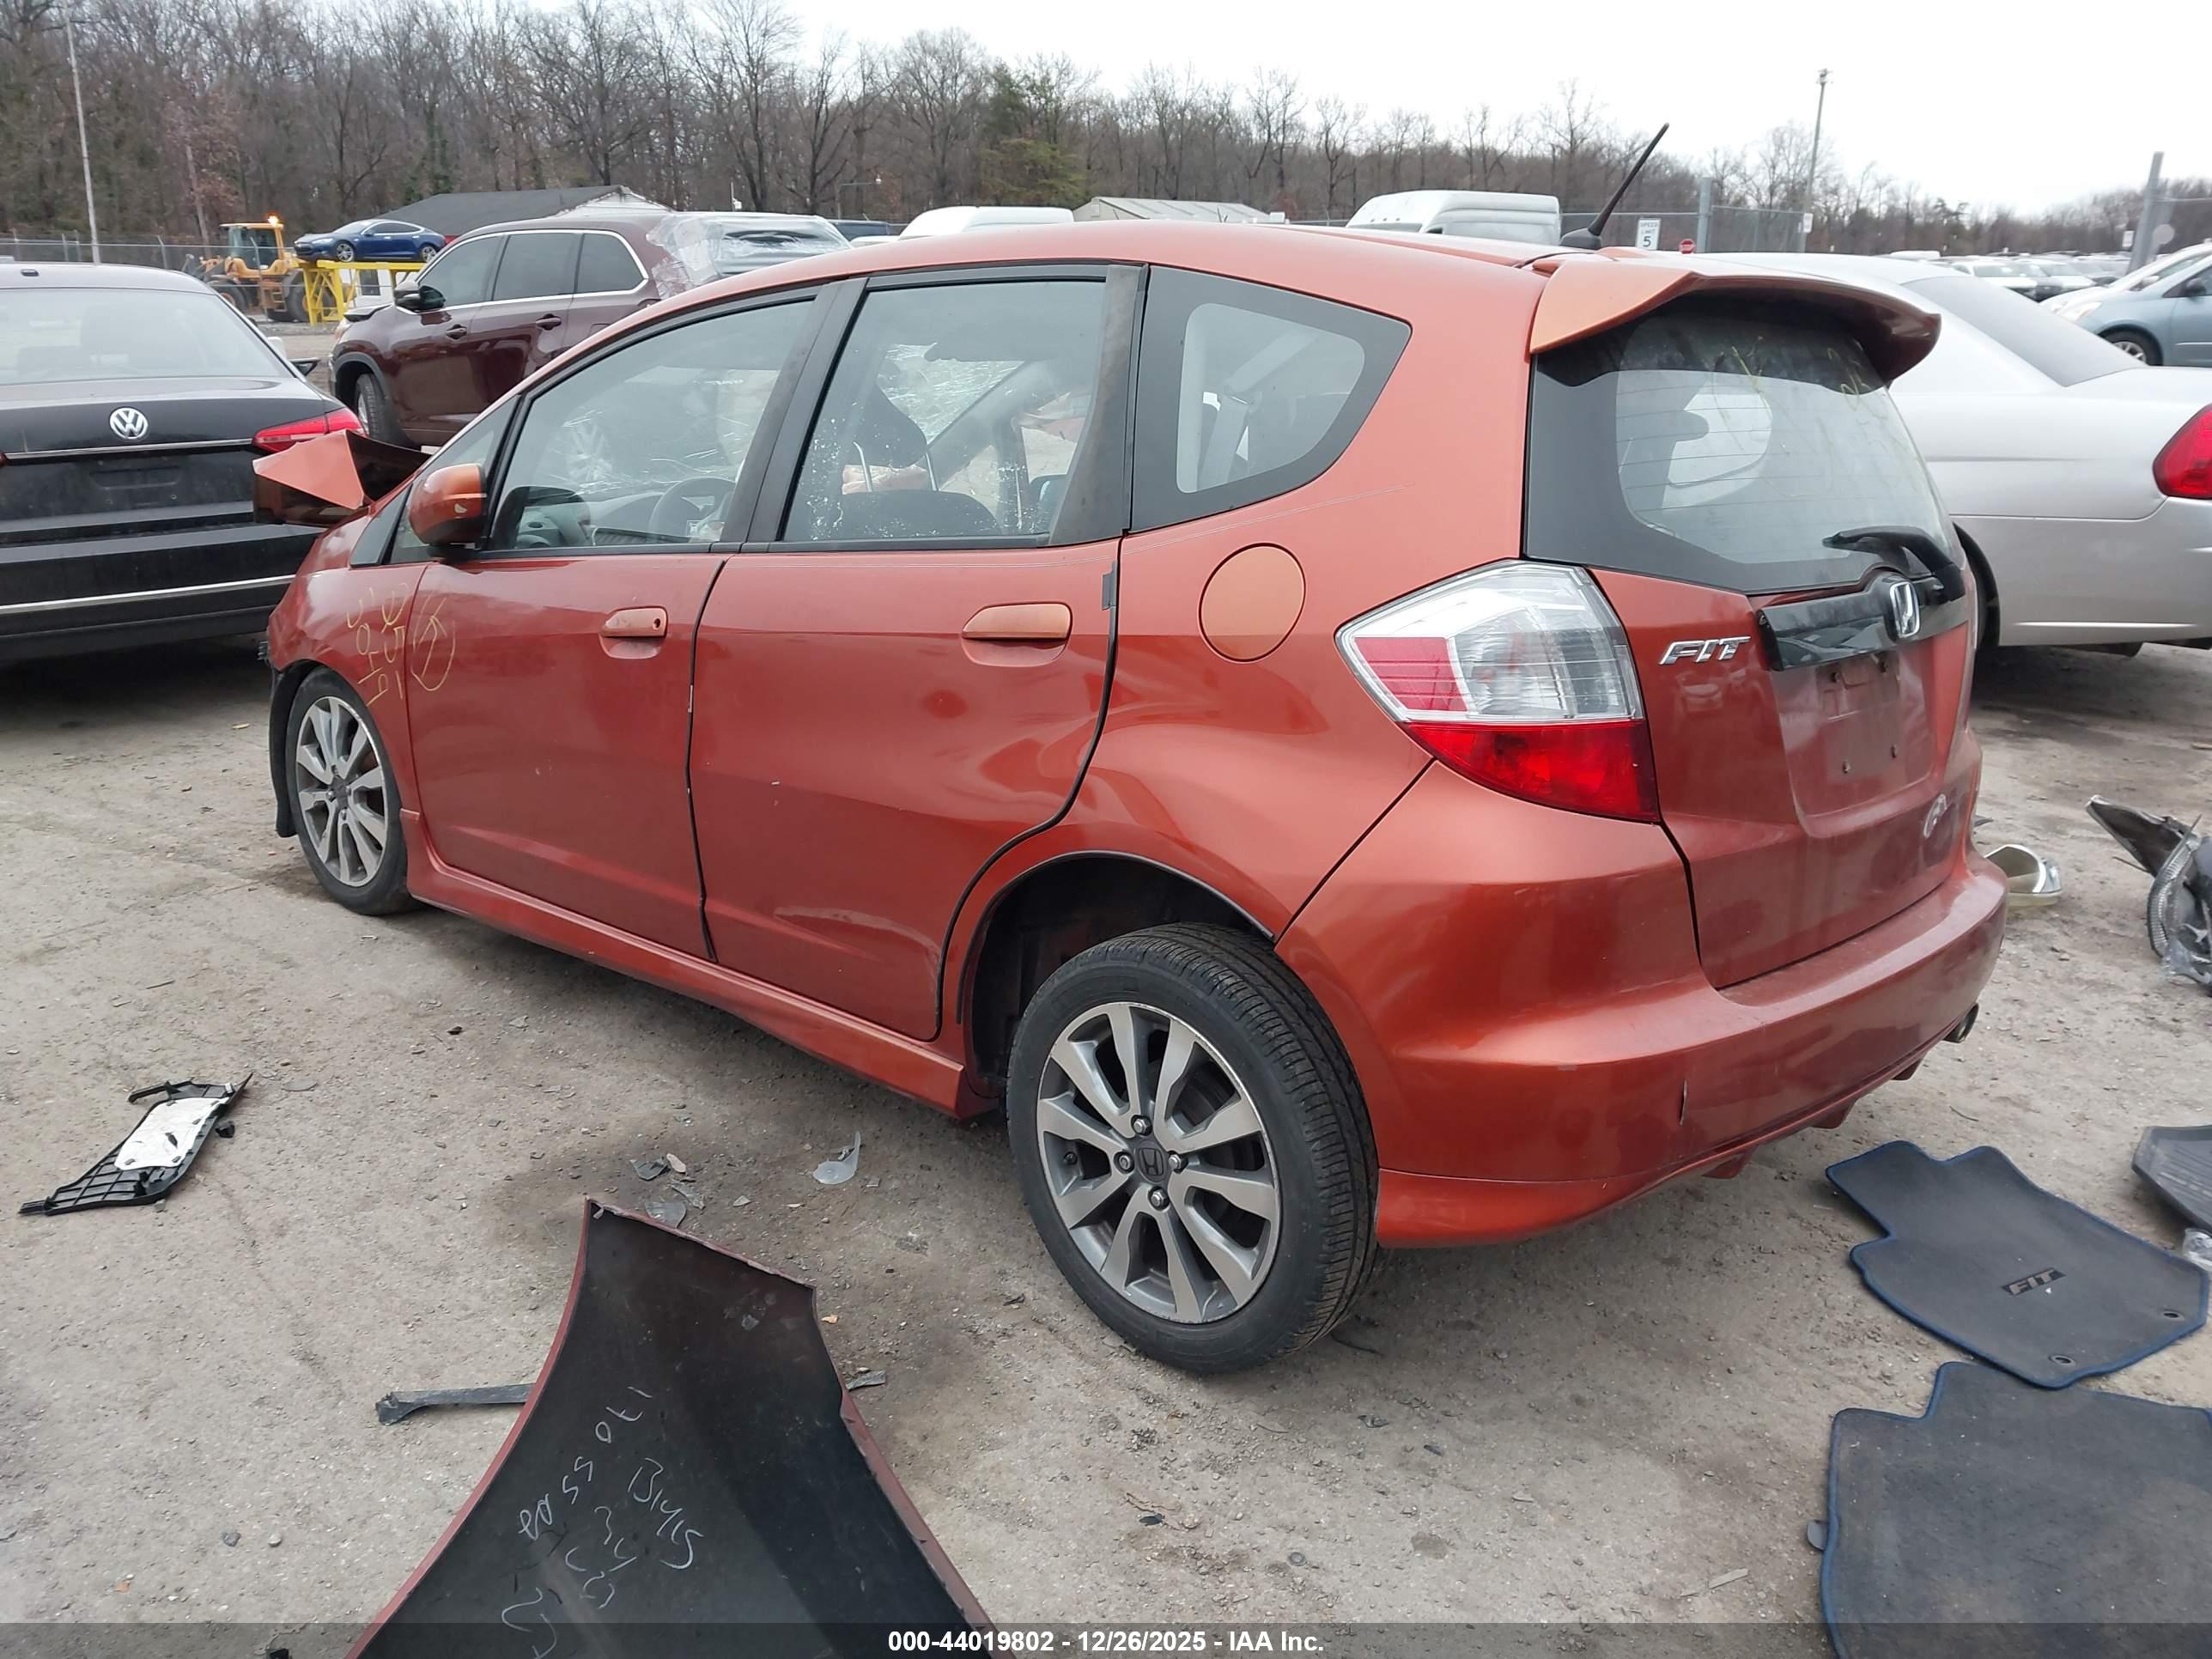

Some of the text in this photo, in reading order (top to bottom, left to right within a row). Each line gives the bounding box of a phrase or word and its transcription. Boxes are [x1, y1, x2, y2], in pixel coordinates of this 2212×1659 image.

[1643, 236, 1651, 247] 5
[1658, 635, 1752, 665] FIT
[2009, 1269, 2055, 1295] FIT
